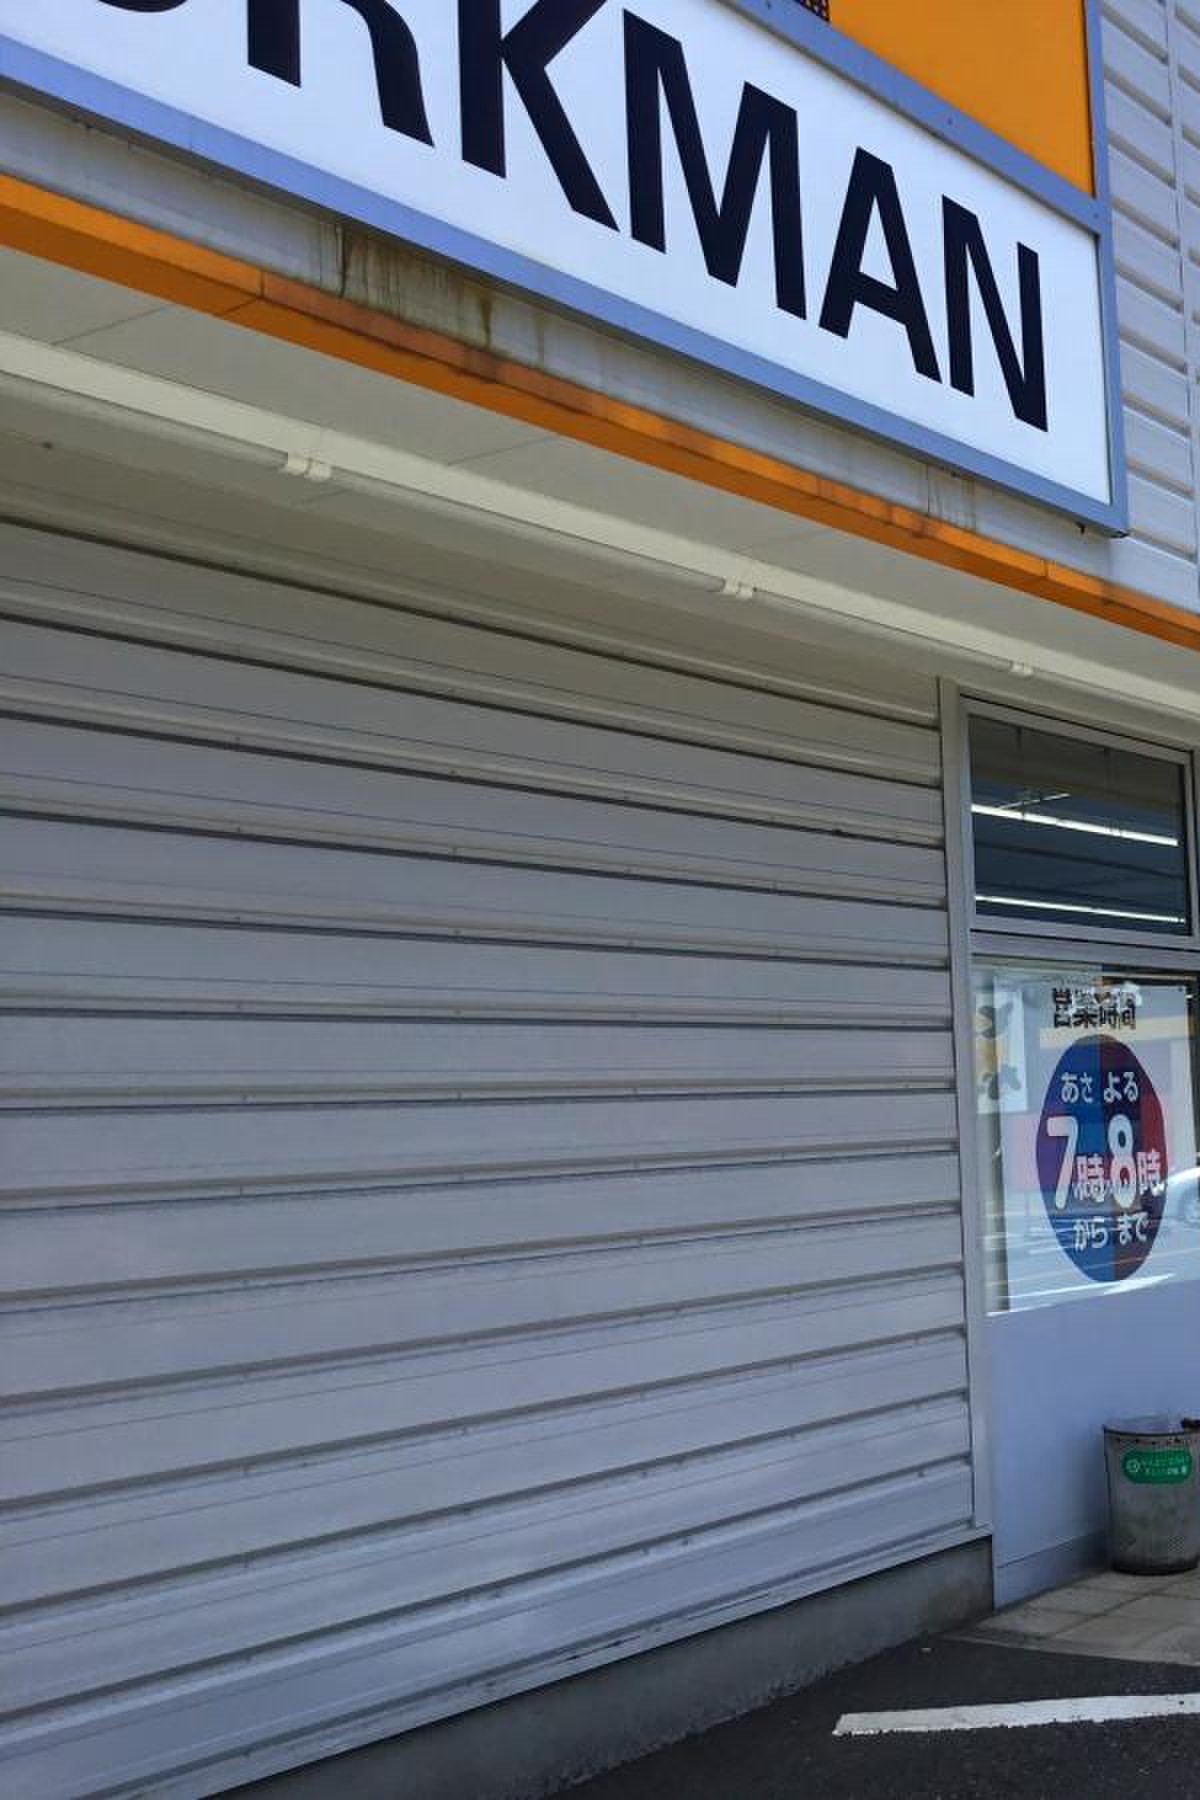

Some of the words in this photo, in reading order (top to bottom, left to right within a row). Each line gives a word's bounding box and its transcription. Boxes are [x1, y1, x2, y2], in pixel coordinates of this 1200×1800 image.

[1061, 1072, 1093, 1103] あさ
[1103, 1072, 1139, 1103] よる
[1073, 1217, 1109, 1251] から
[1117, 1211, 1149, 1245] まで
